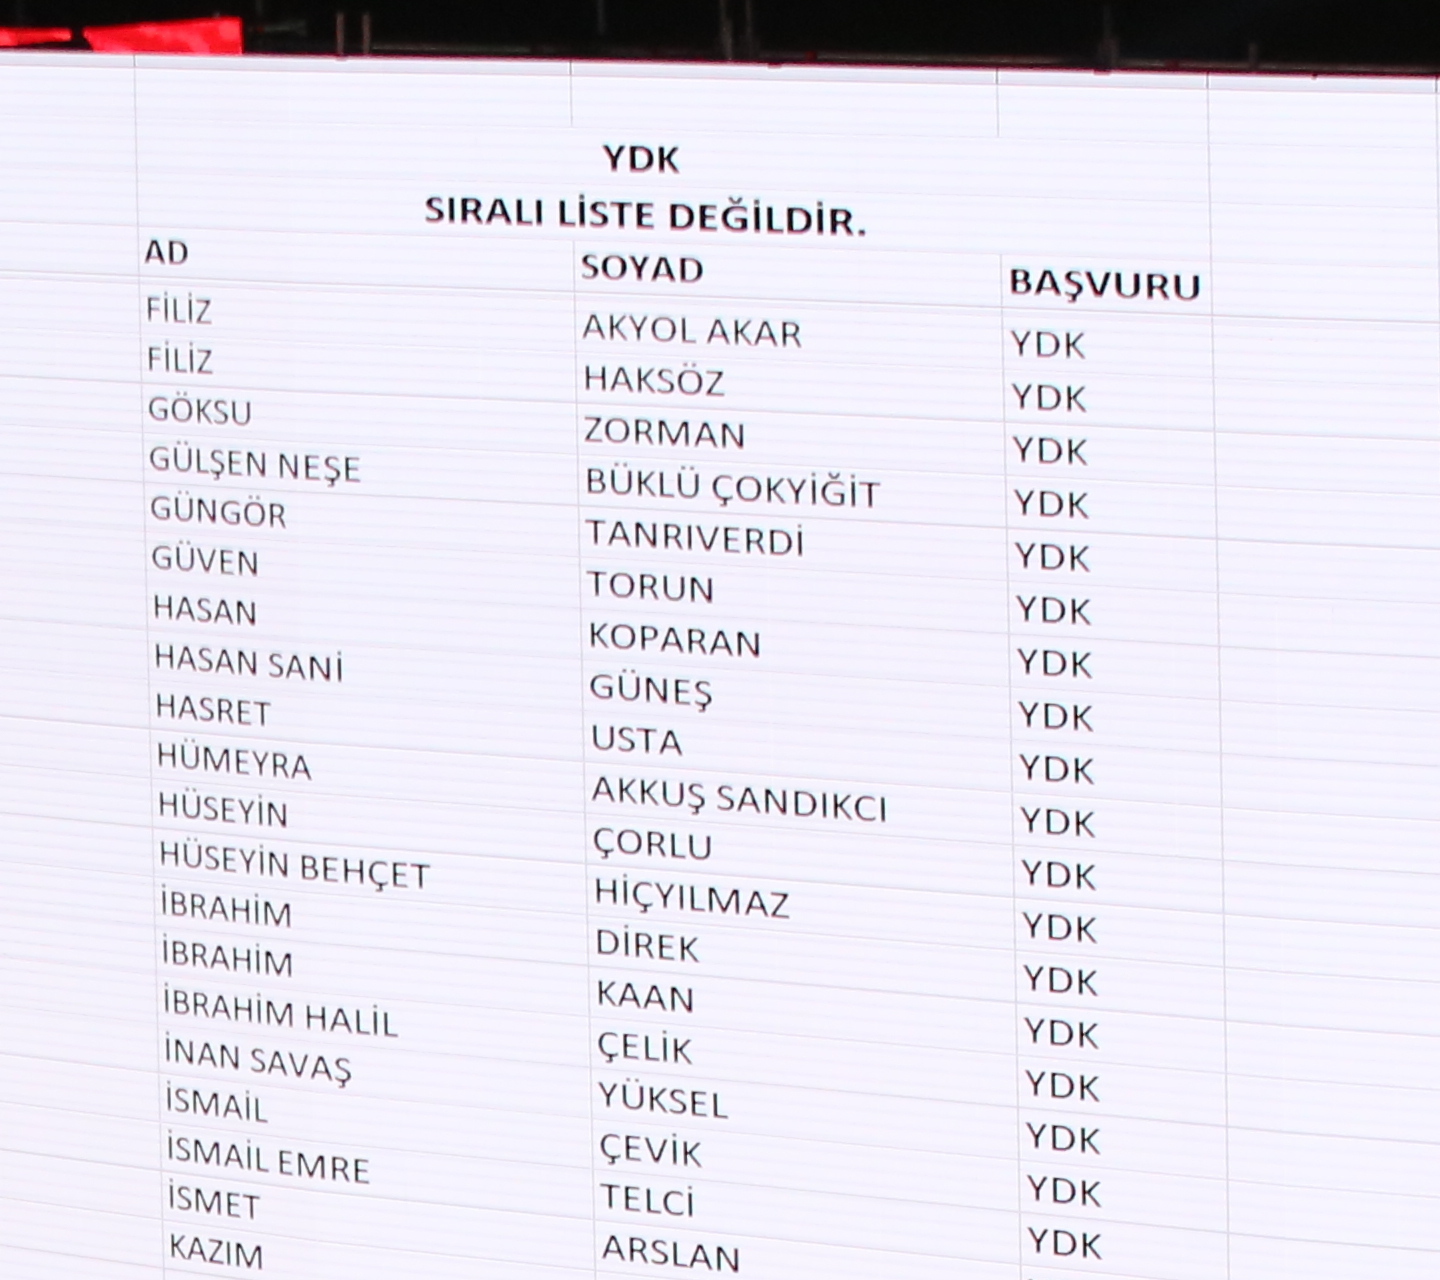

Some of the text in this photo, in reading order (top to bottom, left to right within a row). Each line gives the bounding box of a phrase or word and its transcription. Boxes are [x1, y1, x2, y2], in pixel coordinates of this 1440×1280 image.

[603, 144, 678, 173] YDK
[425, 194, 866, 236] SIRALI LİSTE DEĞİLDİR.
[145, 239, 188, 264] AD
[582, 254, 704, 282] SOYAD
[1010, 268, 1200, 303] BAŞVURU
[147, 293, 211, 323] FİLİZ
[583, 314, 801, 347] AKYOL AKAR
[1012, 331, 1084, 357] YDK
[148, 343, 212, 373] FİLİZ
[585, 365, 723, 395] HAKSÖZ
[148, 393, 252, 423] GÖKSU
[1012, 384, 1085, 411] YDK
[585, 417, 744, 448] ZORMAN
[149, 445, 360, 486] GÜLŞEN NEŞE
[1013, 436, 1086, 464] YDK
[587, 468, 880, 507] BÜKLÜ ÇOKYİĞİT
[1014, 489, 1088, 518] YDK
[151, 497, 285, 527] GÜNGÖR
[590, 519, 803, 556] TANRIVERDİ
[152, 546, 258, 575] GÜVEN
[1015, 542, 1089, 571] YDK
[591, 571, 713, 603] TORUN
[154, 594, 256, 625] HASAN
[1016, 595, 1090, 625] YDK
[590, 622, 760, 657] KOPARAN
[155, 644, 342, 681] HASAN SANİ
[1017, 648, 1091, 678] YDK
[590, 669, 712, 712] GÜNEŞ
[157, 693, 268, 725] HASRET
[1018, 701, 1092, 731] YDK
[592, 725, 682, 755] USTA
[158, 743, 311, 779] HÜMEYRA
[1019, 754, 1093, 784] YDK
[159, 792, 287, 827] HÜSEYİN
[592, 776, 886, 822] AKKUŞ SANDIKCI
[1021, 807, 1094, 837] YDK
[593, 827, 711, 860] ÇORLU
[160, 841, 430, 892] HÜSEYİN BEHÇET
[1022, 859, 1095, 890] YDK
[162, 887, 291, 927] İBRAHİM
[596, 878, 789, 918] HİÇYILMAZ
[597, 925, 698, 962] DİREK
[1023, 912, 1096, 943] YDK
[163, 936, 292, 976] İBRAHİM
[598, 980, 693, 1013] KAAN
[1024, 965, 1097, 996] YDK
[164, 985, 397, 1037] İBRAHİM HALİL
[598, 1030, 691, 1064] ÇELİK
[1024, 1017, 1098, 1049] YDK
[166, 1034, 352, 1088] İNAN SAVAŞ
[599, 1082, 728, 1119] YÜKSEL
[1026, 1070, 1099, 1102] YDK
[167, 1083, 265, 1122] İSMAİL
[600, 1133, 701, 1167] ÇEVİK
[1026, 1122, 1099, 1154] YDK
[168, 1132, 369, 1184] İSMAİL EMRE
[169, 1181, 259, 1218] İSMET
[601, 1183, 693, 1217] TELCİ
[1027, 1175, 1100, 1207] YDK
[171, 1234, 262, 1269] KAZIM
[602, 1235, 739, 1273] ARSLAN
[1028, 1227, 1101, 1260] YDK
